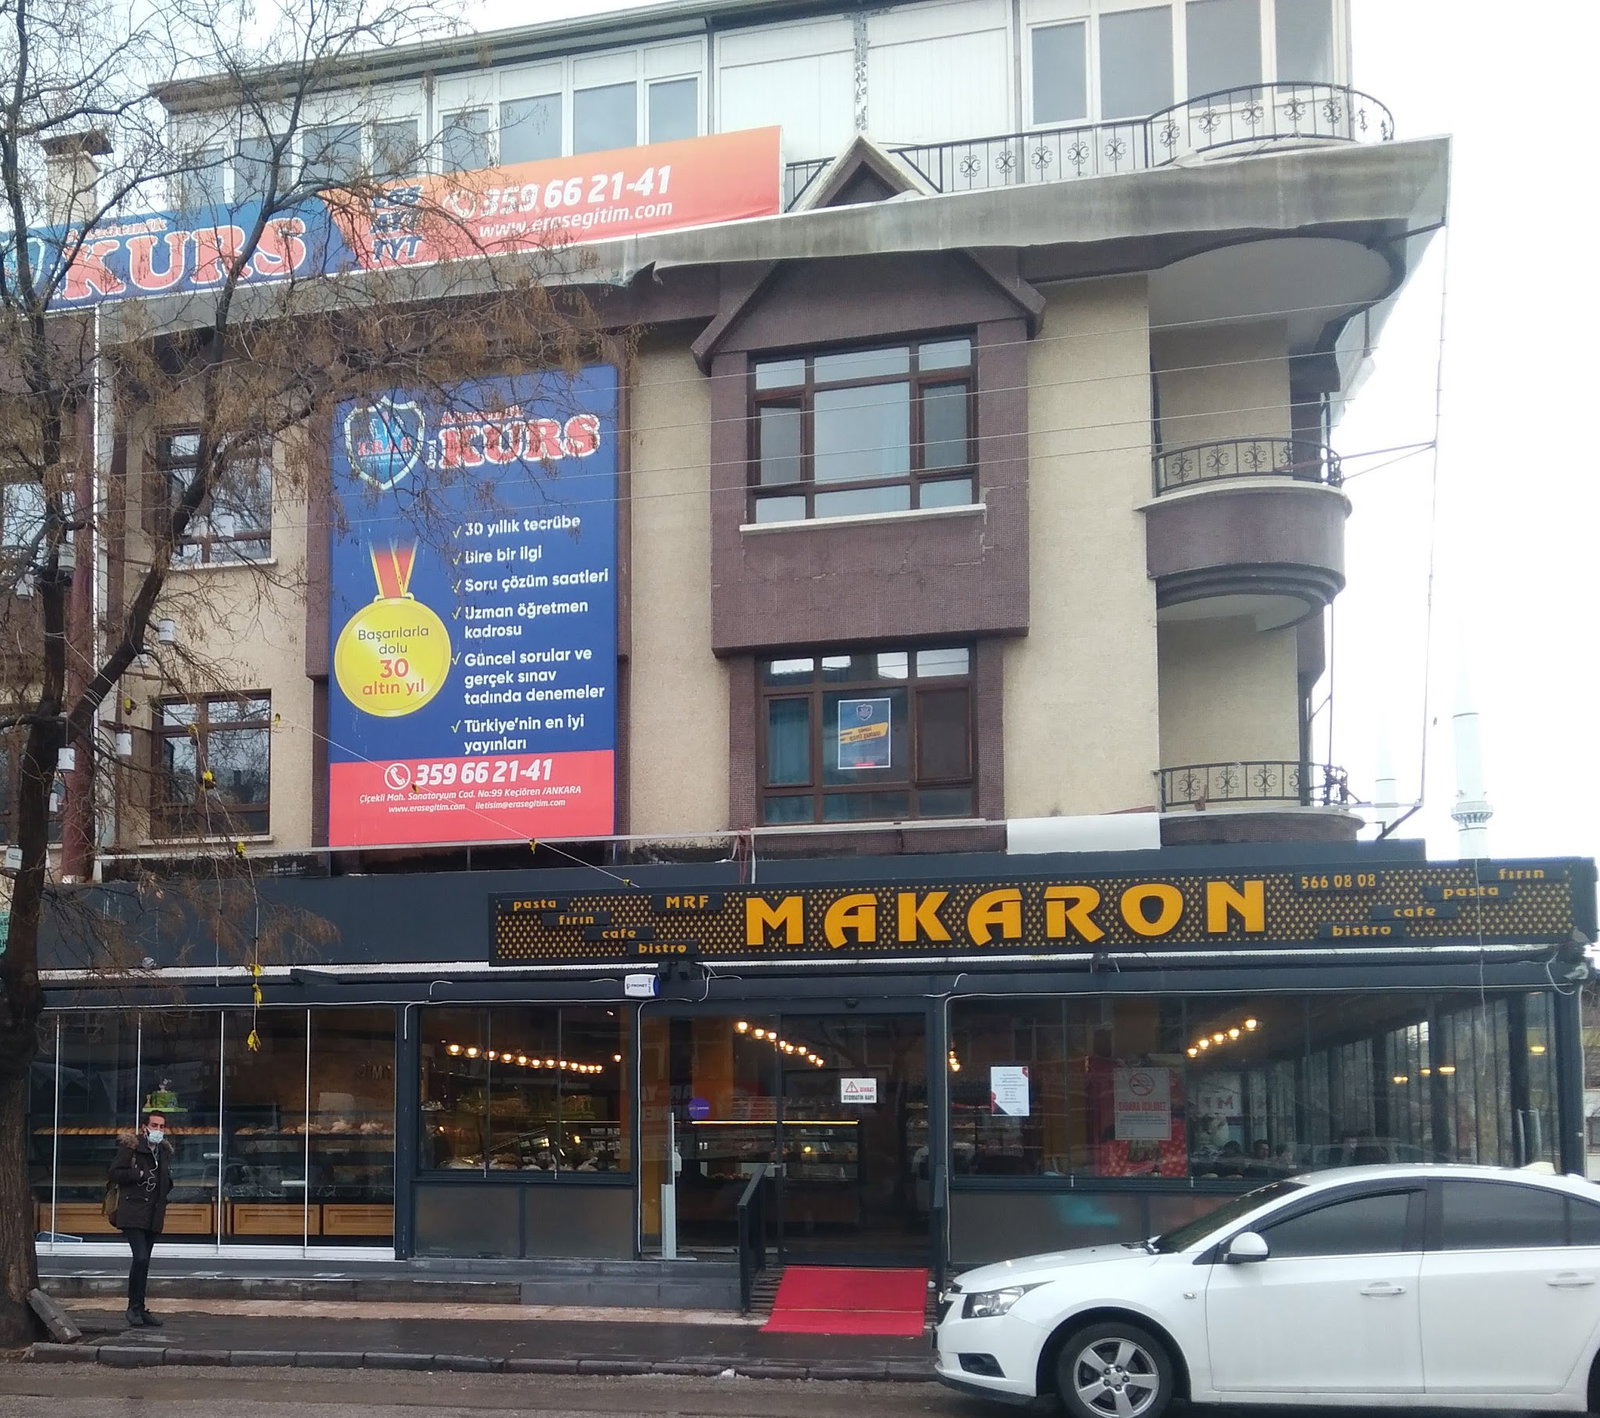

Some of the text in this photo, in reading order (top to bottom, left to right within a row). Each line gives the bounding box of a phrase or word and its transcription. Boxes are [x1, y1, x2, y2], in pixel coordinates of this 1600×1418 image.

[480, 165, 671, 217] 359 66 21-41
[372, 234, 423, 262] TYT
[62, 218, 306, 300] KURS
[438, 414, 600, 470] KURS
[465, 514, 581, 537] 30 yıllık tecrübe
[497, 547, 516, 562] bir
[520, 545, 542, 563] ilgi
[465, 568, 609, 592] Soru çözüm saatleri
[465, 600, 588, 620] Uzman öğretmen
[358, 626, 429, 642] Başarılarla
[464, 625, 522, 639] kadrosu
[379, 642, 408, 655] dolu
[464, 648, 593, 667] Güncel sorular ve
[380, 658, 409, 678] 30
[362, 678, 425, 696] altın yıl
[464, 669, 557, 689] gerçek sınav
[464, 684, 605, 705] tadında denemeler
[545, 717, 563, 729] en
[567, 713, 585, 731] iyi
[464, 737, 527, 755] yayınları
[416, 758, 553, 787] 359 66 21-41
[360, 785, 581, 804] Çiçekli Mah. Sanatoryum Cad. No:99 Keçiören /ANKARA
[389, 802, 466, 812] www.erasegitim.com
[1302, 873, 1376, 889] 566 08 08
[1499, 868, 1545, 880] fırın
[1442, 885, 1499, 900] pasta
[512, 898, 557, 911] pasta
[665, 895, 710, 909] MRF
[558, 914, 595, 925] fırın
[745, 880, 1266, 949] MAKARON
[1393, 905, 1437, 918] cafe
[602, 928, 637, 939] cafe
[1332, 924, 1392, 937] bistro
[638, 943, 687, 954] bistro
